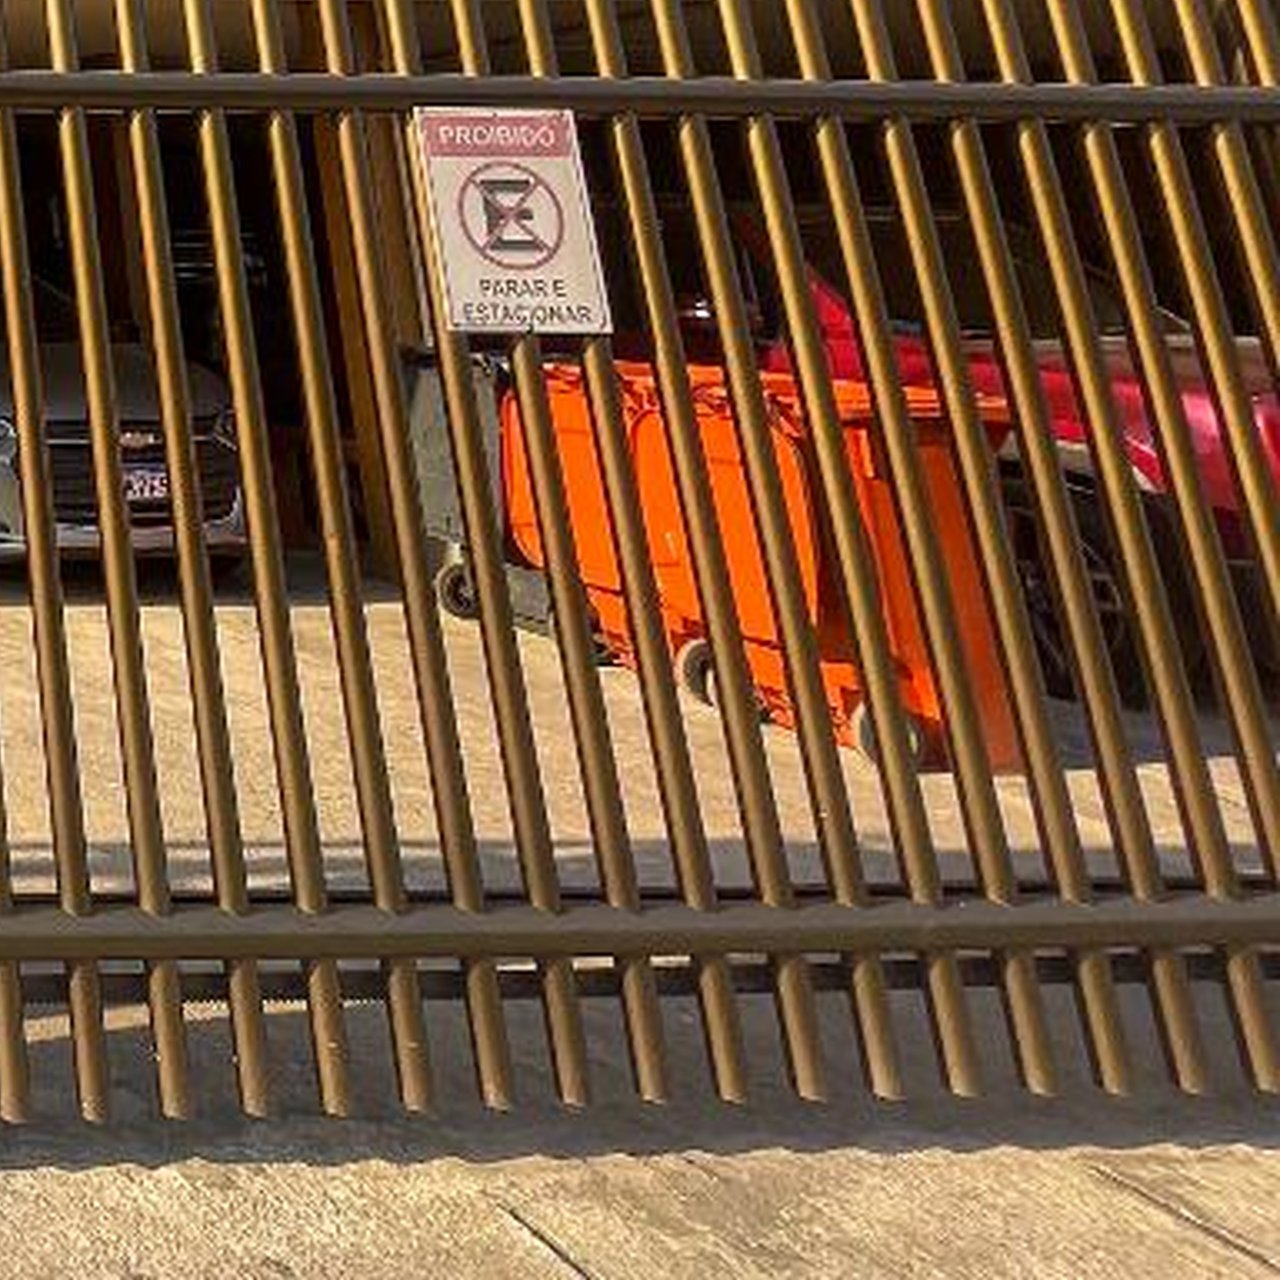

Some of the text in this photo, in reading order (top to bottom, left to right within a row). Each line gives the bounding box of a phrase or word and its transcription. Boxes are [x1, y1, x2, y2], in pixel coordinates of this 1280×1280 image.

[438, 125, 555, 147] PROIBIDO
[479, 278, 568, 298] PARAR E
[462, 303, 592, 324] ESTACIONAR
